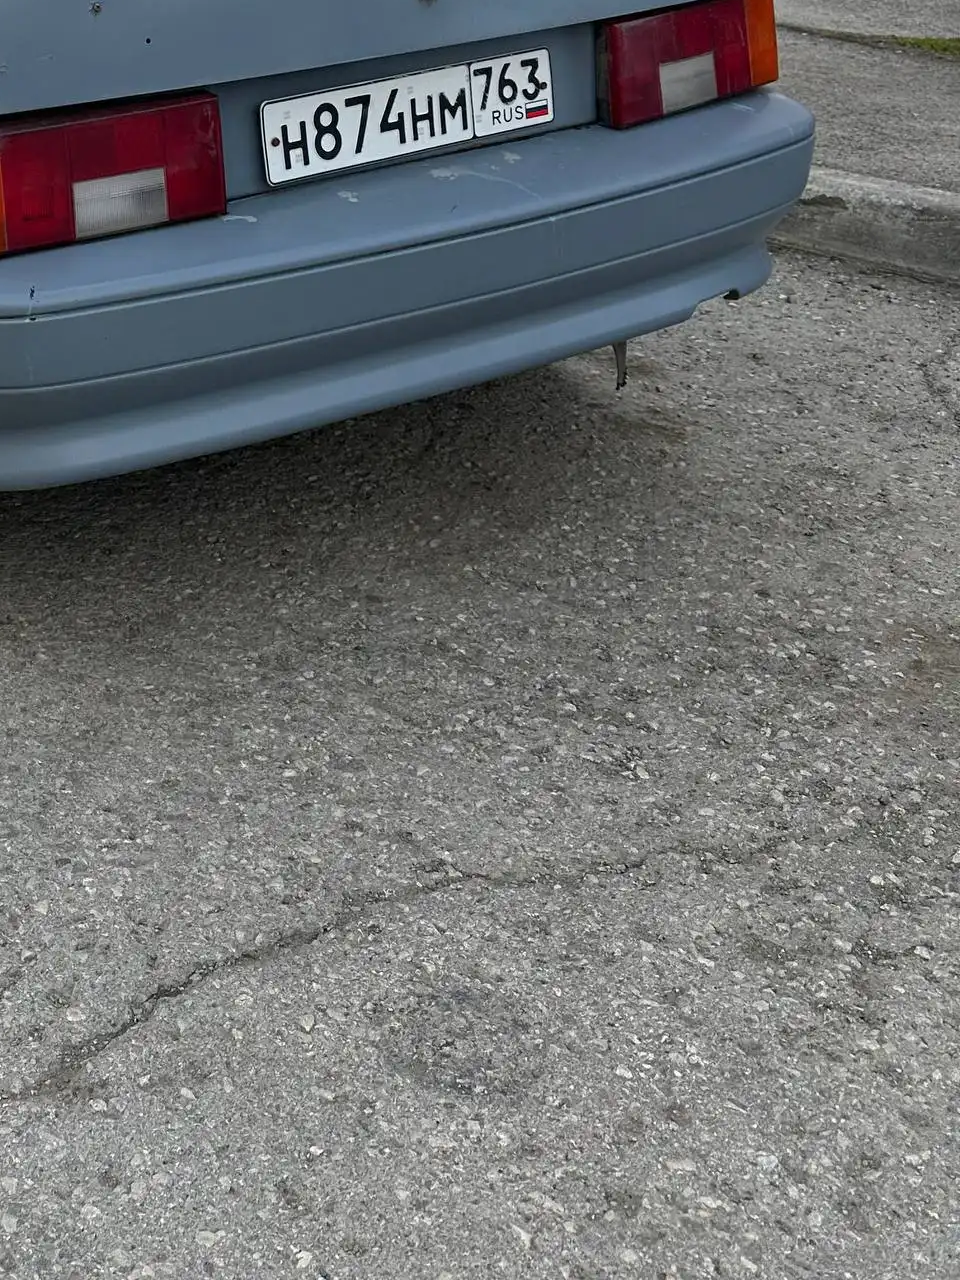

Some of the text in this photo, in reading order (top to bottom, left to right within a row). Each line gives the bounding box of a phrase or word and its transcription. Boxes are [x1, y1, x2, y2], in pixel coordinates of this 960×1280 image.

[281, 58, 543, 170] Н874НМ 763
[492, 106, 524, 126] RUS
